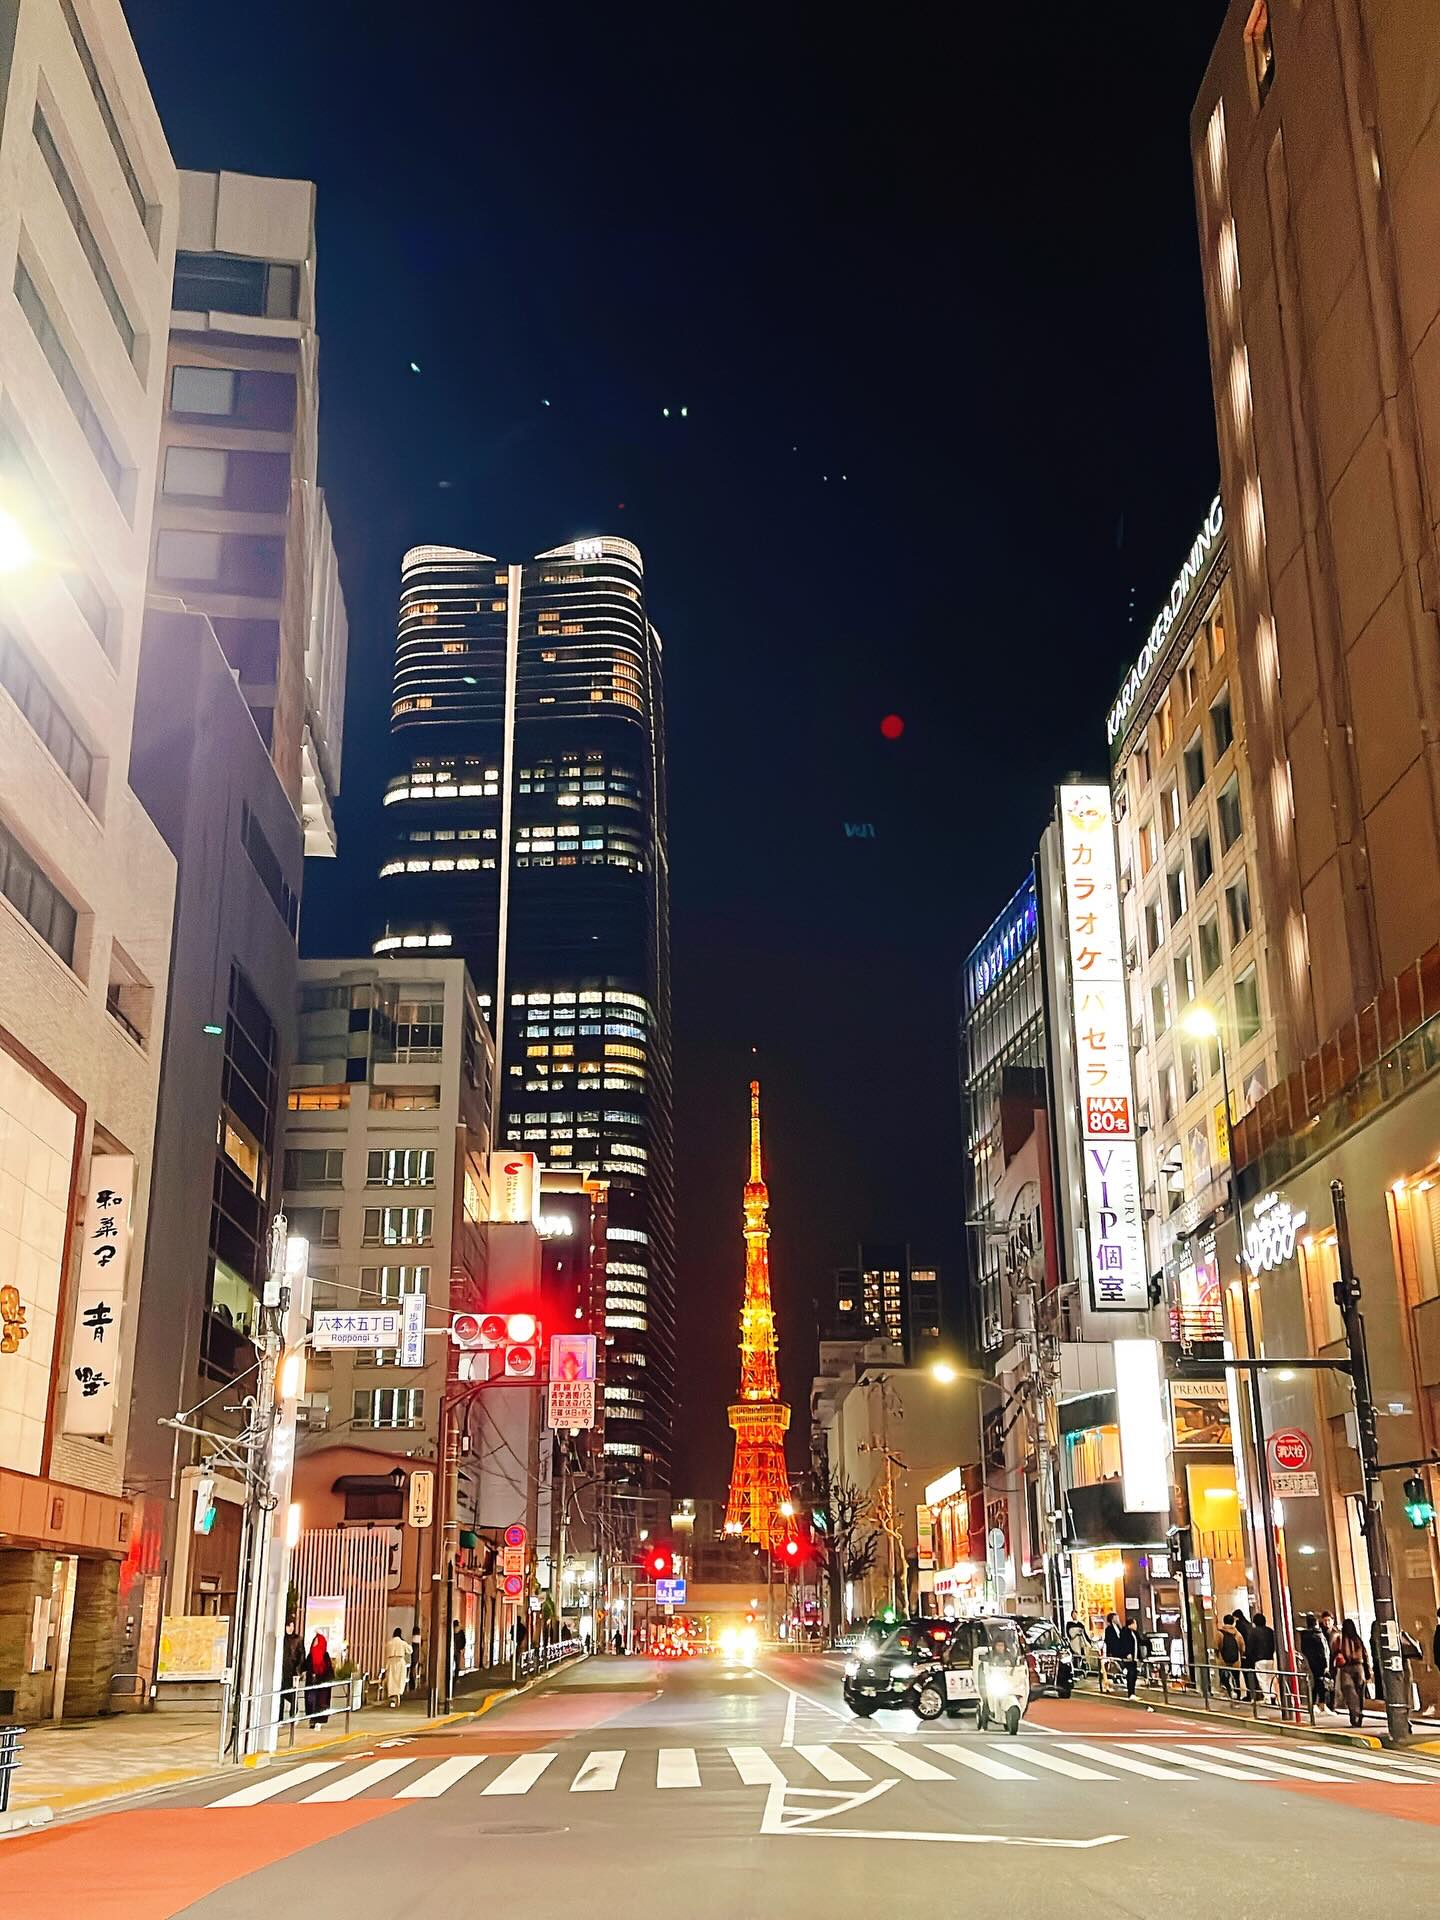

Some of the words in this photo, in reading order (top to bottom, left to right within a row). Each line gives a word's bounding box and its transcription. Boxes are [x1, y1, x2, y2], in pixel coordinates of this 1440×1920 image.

[1107, 495, 1224, 746] KARAOKE&DINING
[1071, 842, 1103, 972] カラオケ
[1089, 1098, 1125, 1112] MAX
[1089, 1112, 1127, 1131] 80名
[90, 1189, 123, 1268] 和菓子
[318, 1316, 394, 1331] 六本木五丁目
[331, 1334, 370, 1343] Roppongi
[373, 1335, 379, 1343] 5
[1173, 1384, 1225, 1395] PREMIUM
[1277, 1444, 1304, 1458] 消火栓
